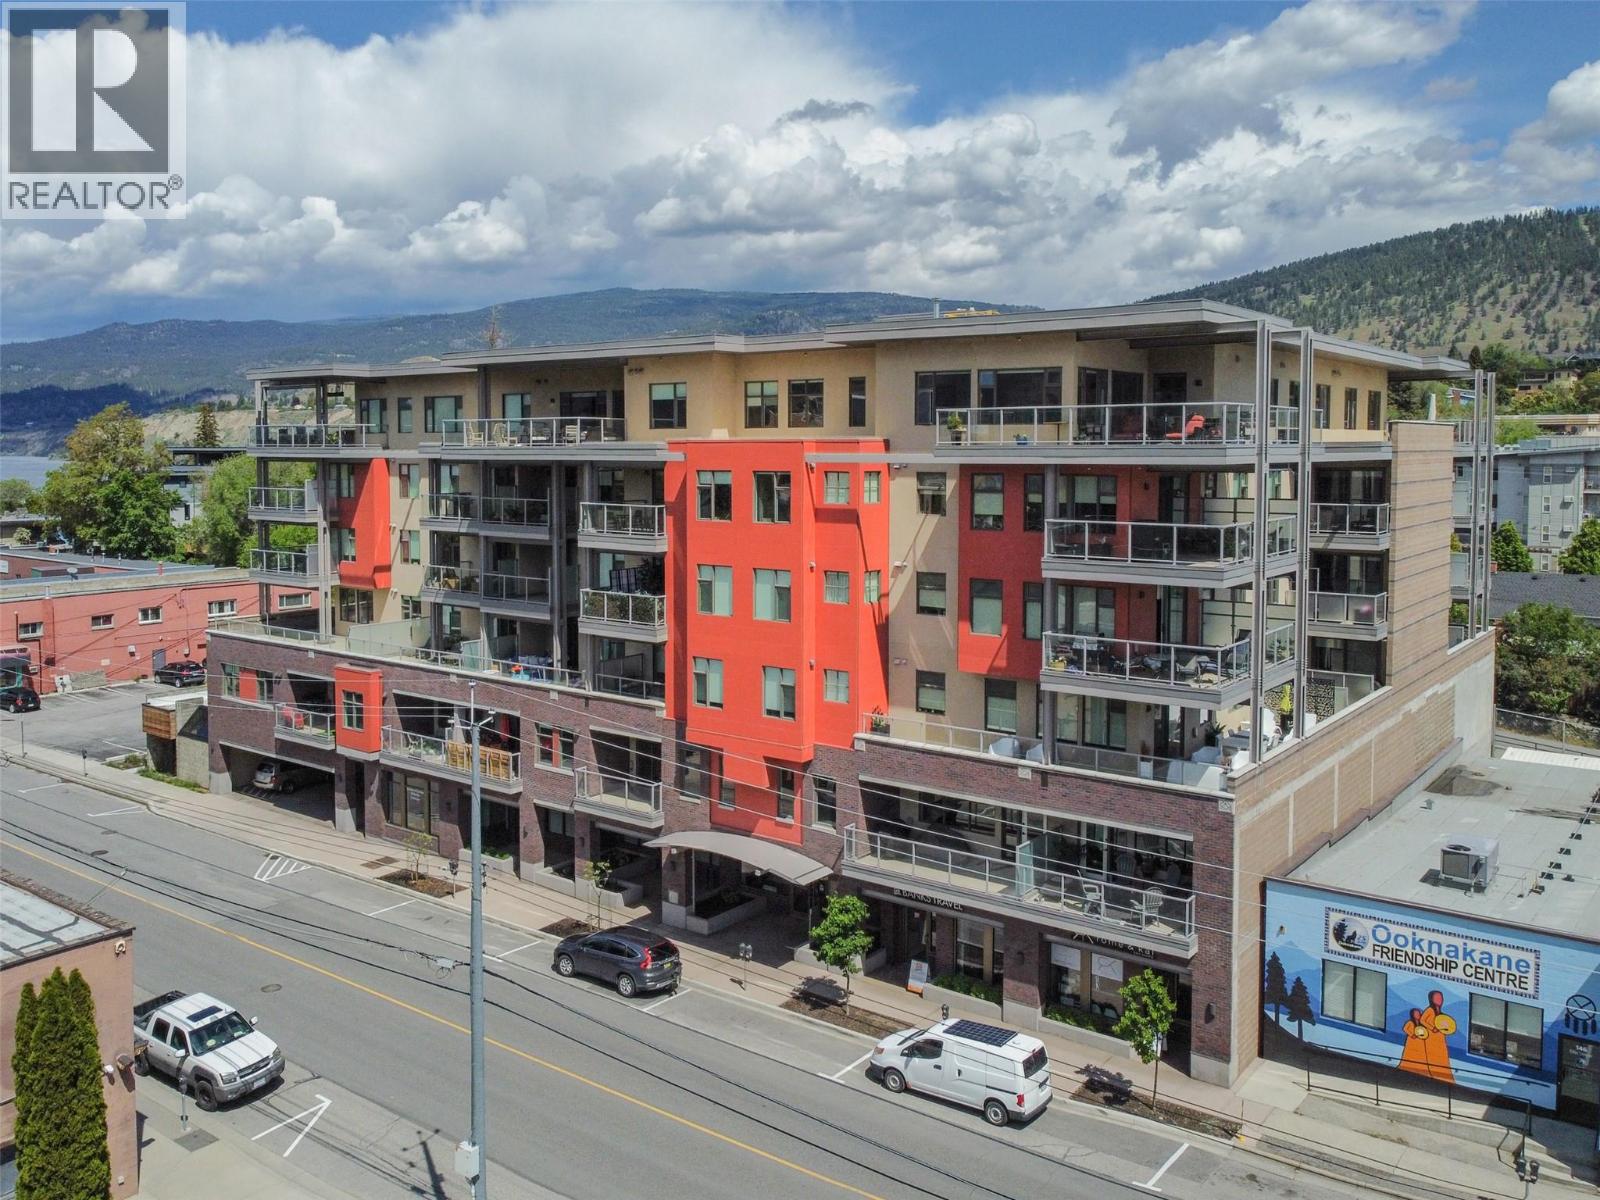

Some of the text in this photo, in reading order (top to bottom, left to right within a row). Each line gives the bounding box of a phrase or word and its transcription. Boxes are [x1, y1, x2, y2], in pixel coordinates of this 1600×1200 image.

[1371, 924, 1531, 975] Ooknakane
[1372, 943, 1529, 990] FRIENDSHIP CENTRE
